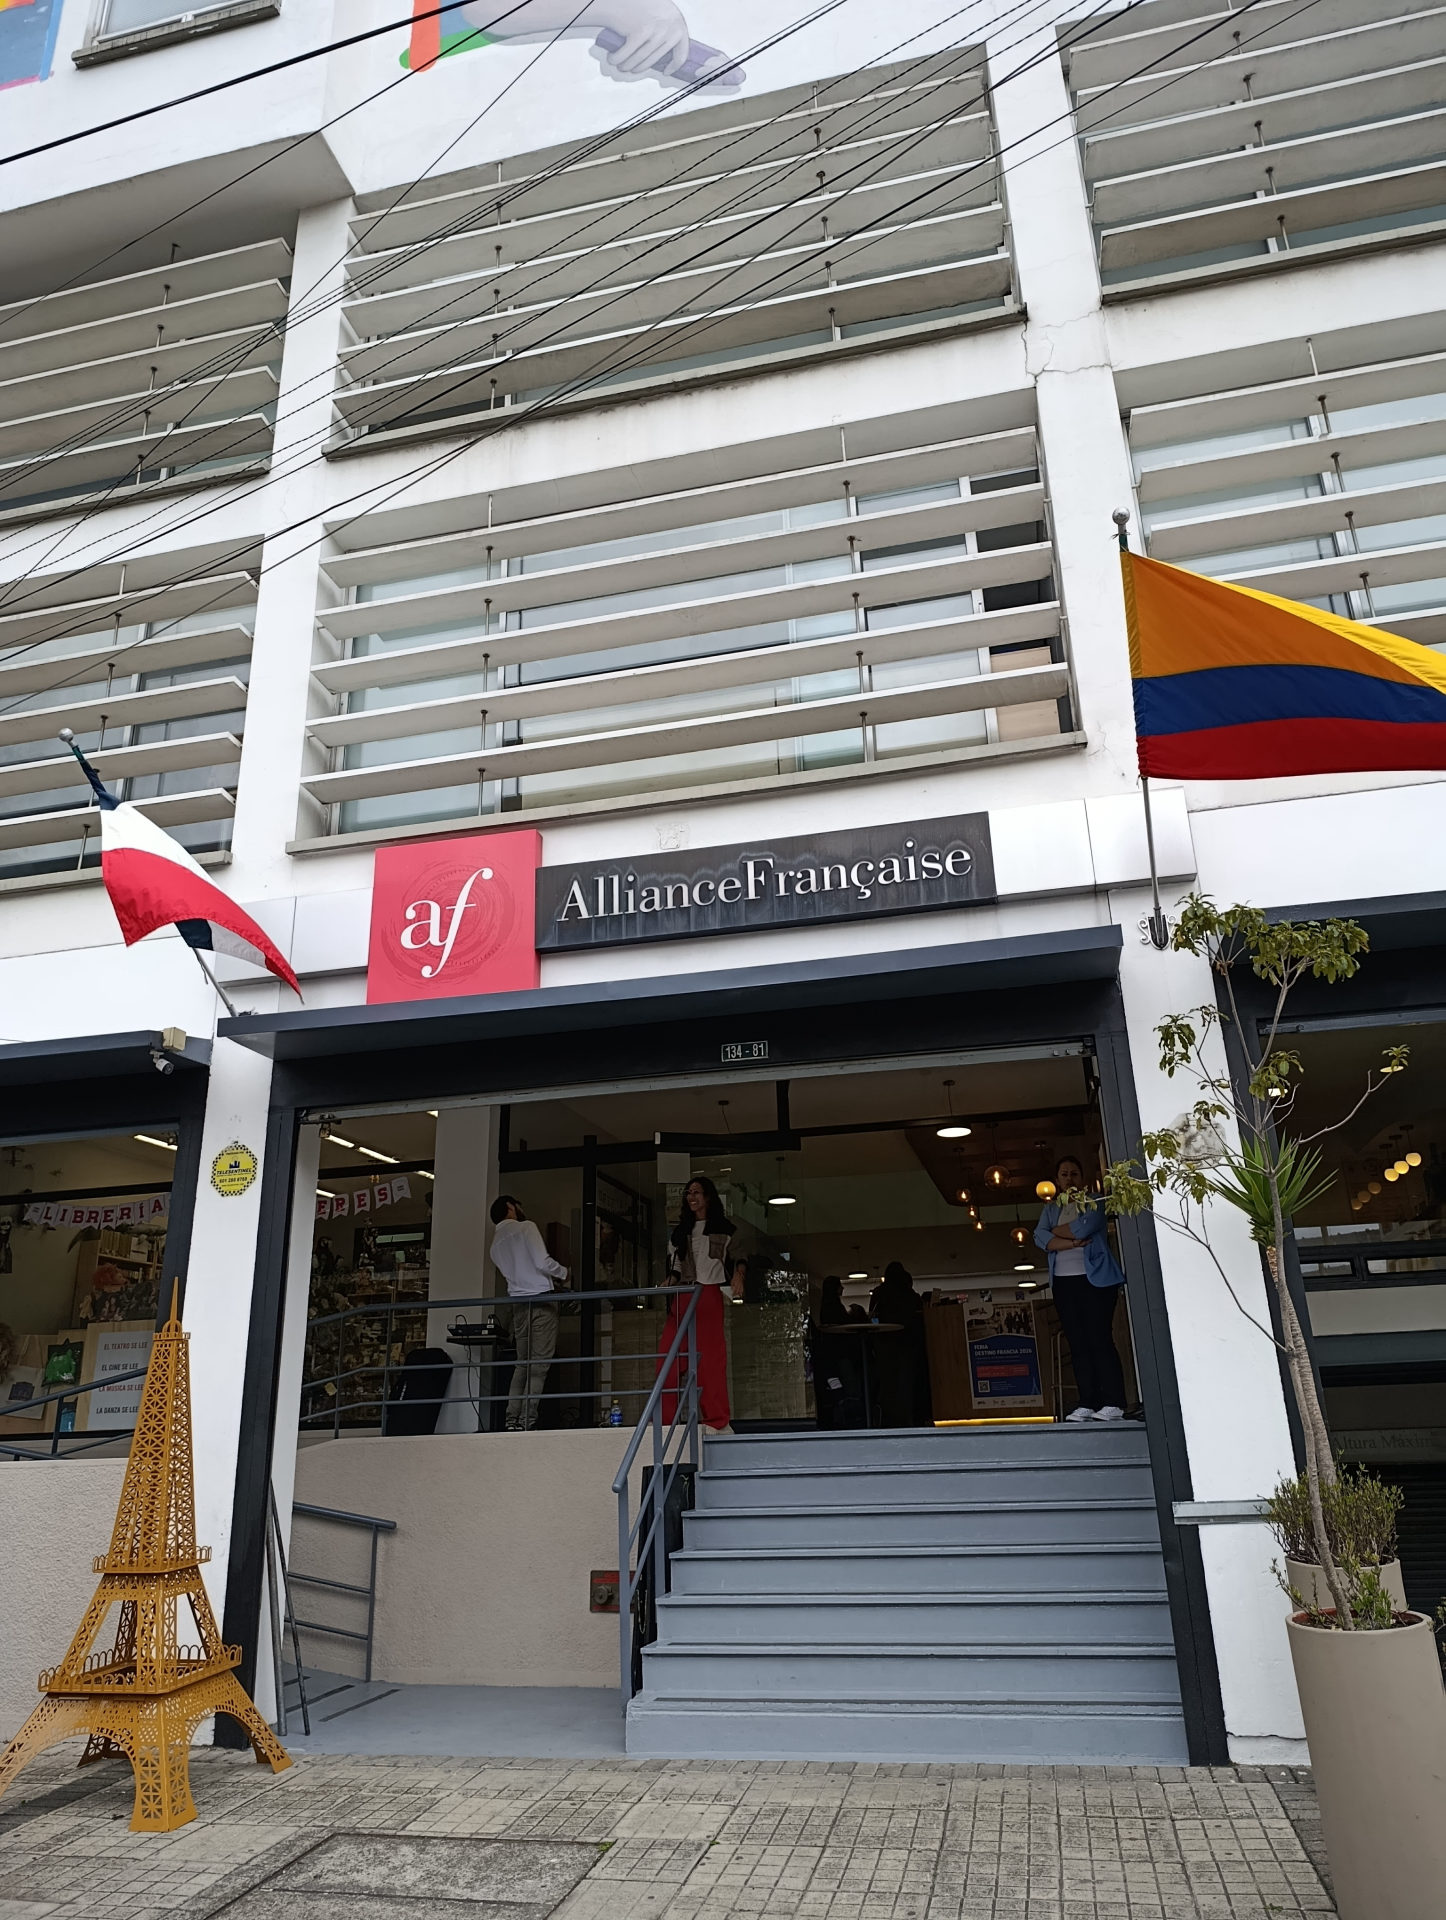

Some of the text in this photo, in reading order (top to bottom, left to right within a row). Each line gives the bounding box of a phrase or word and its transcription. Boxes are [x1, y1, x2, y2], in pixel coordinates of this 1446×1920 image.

[558, 839, 973, 922] AllianceFrançaise
[725, 1044, 742, 1059] 134
[752, 1042, 764, 1057] 81
[43, 1198, 164, 1224] LIBRERÍA
[138, 1341, 148, 1349] LEE
[101, 1364, 108, 1372] EL
[129, 1362, 139, 1370] LEE
[104, 1406, 121, 1414] DANZA
